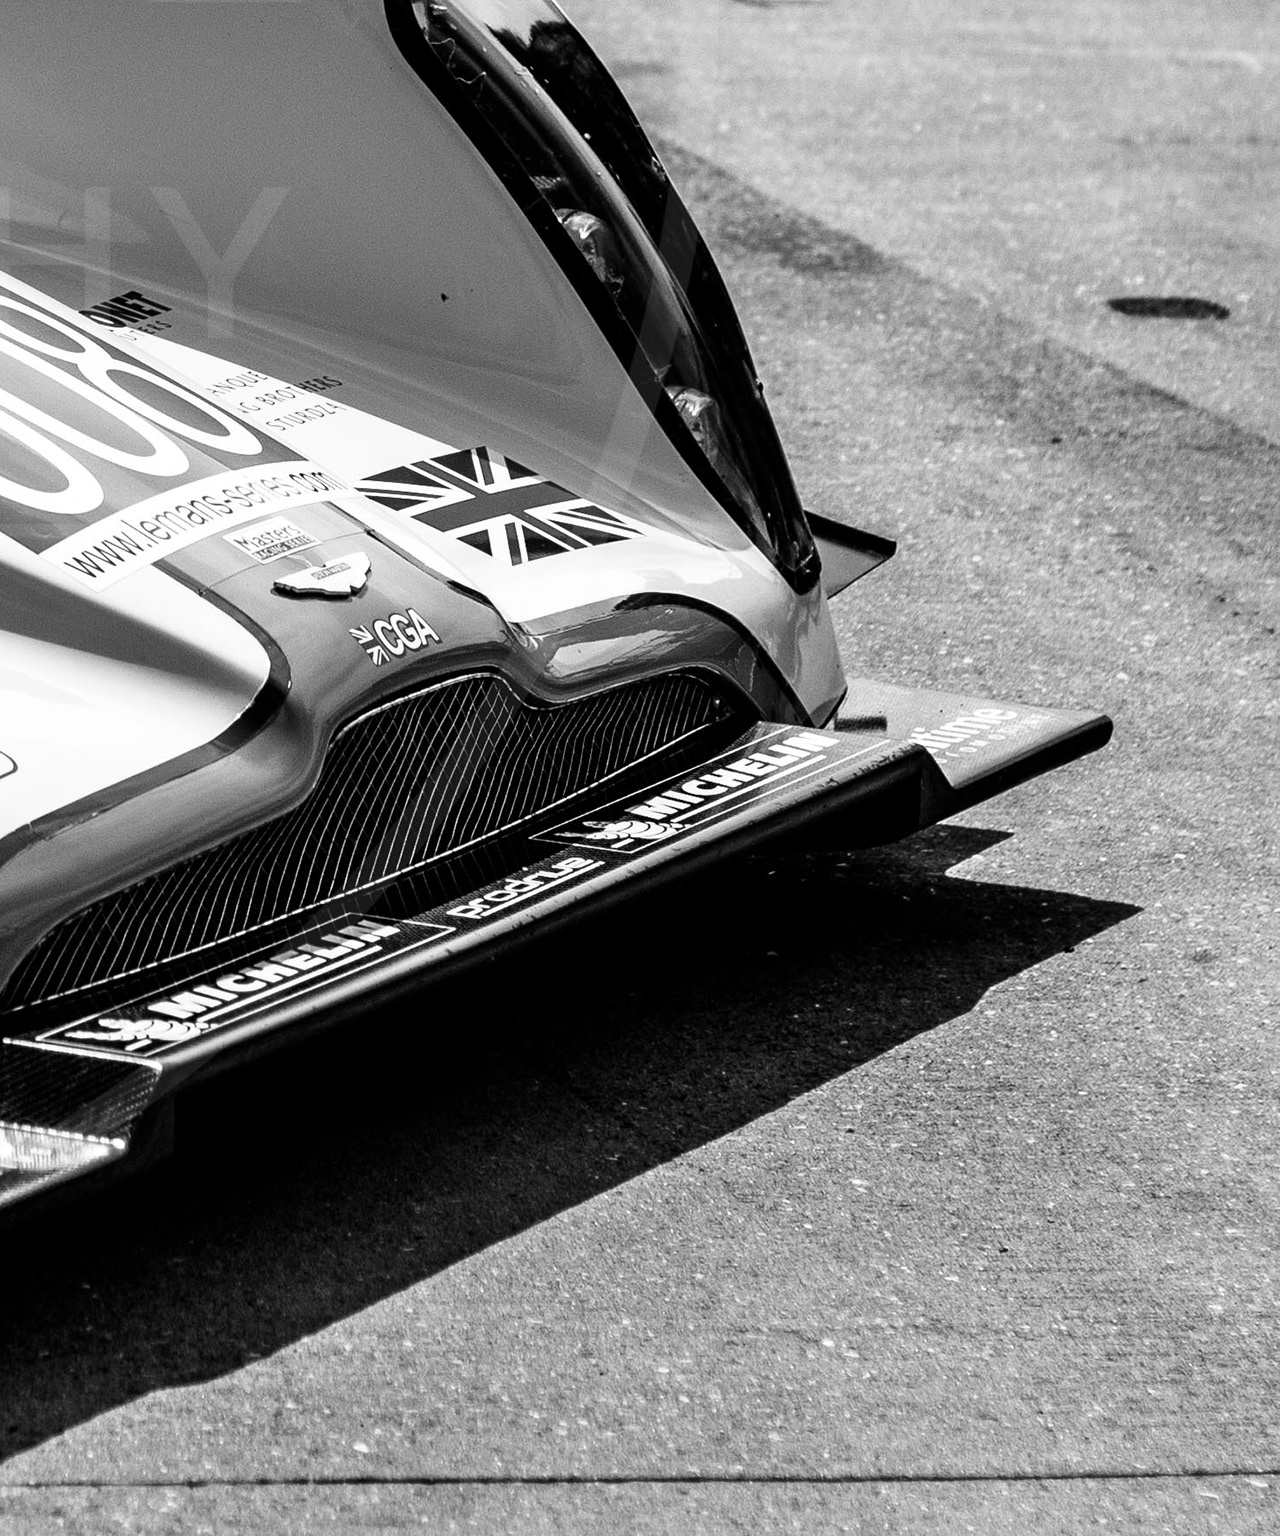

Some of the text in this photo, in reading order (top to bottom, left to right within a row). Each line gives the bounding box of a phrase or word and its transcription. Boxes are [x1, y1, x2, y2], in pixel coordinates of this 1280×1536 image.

[63, 470, 348, 579] www.lemans-series.com
[372, 607, 441, 657] CGA
[632, 730, 841, 821] MICHELIN
[446, 855, 595, 920] prodrive
[147, 918, 401, 1019] MICHELIN
